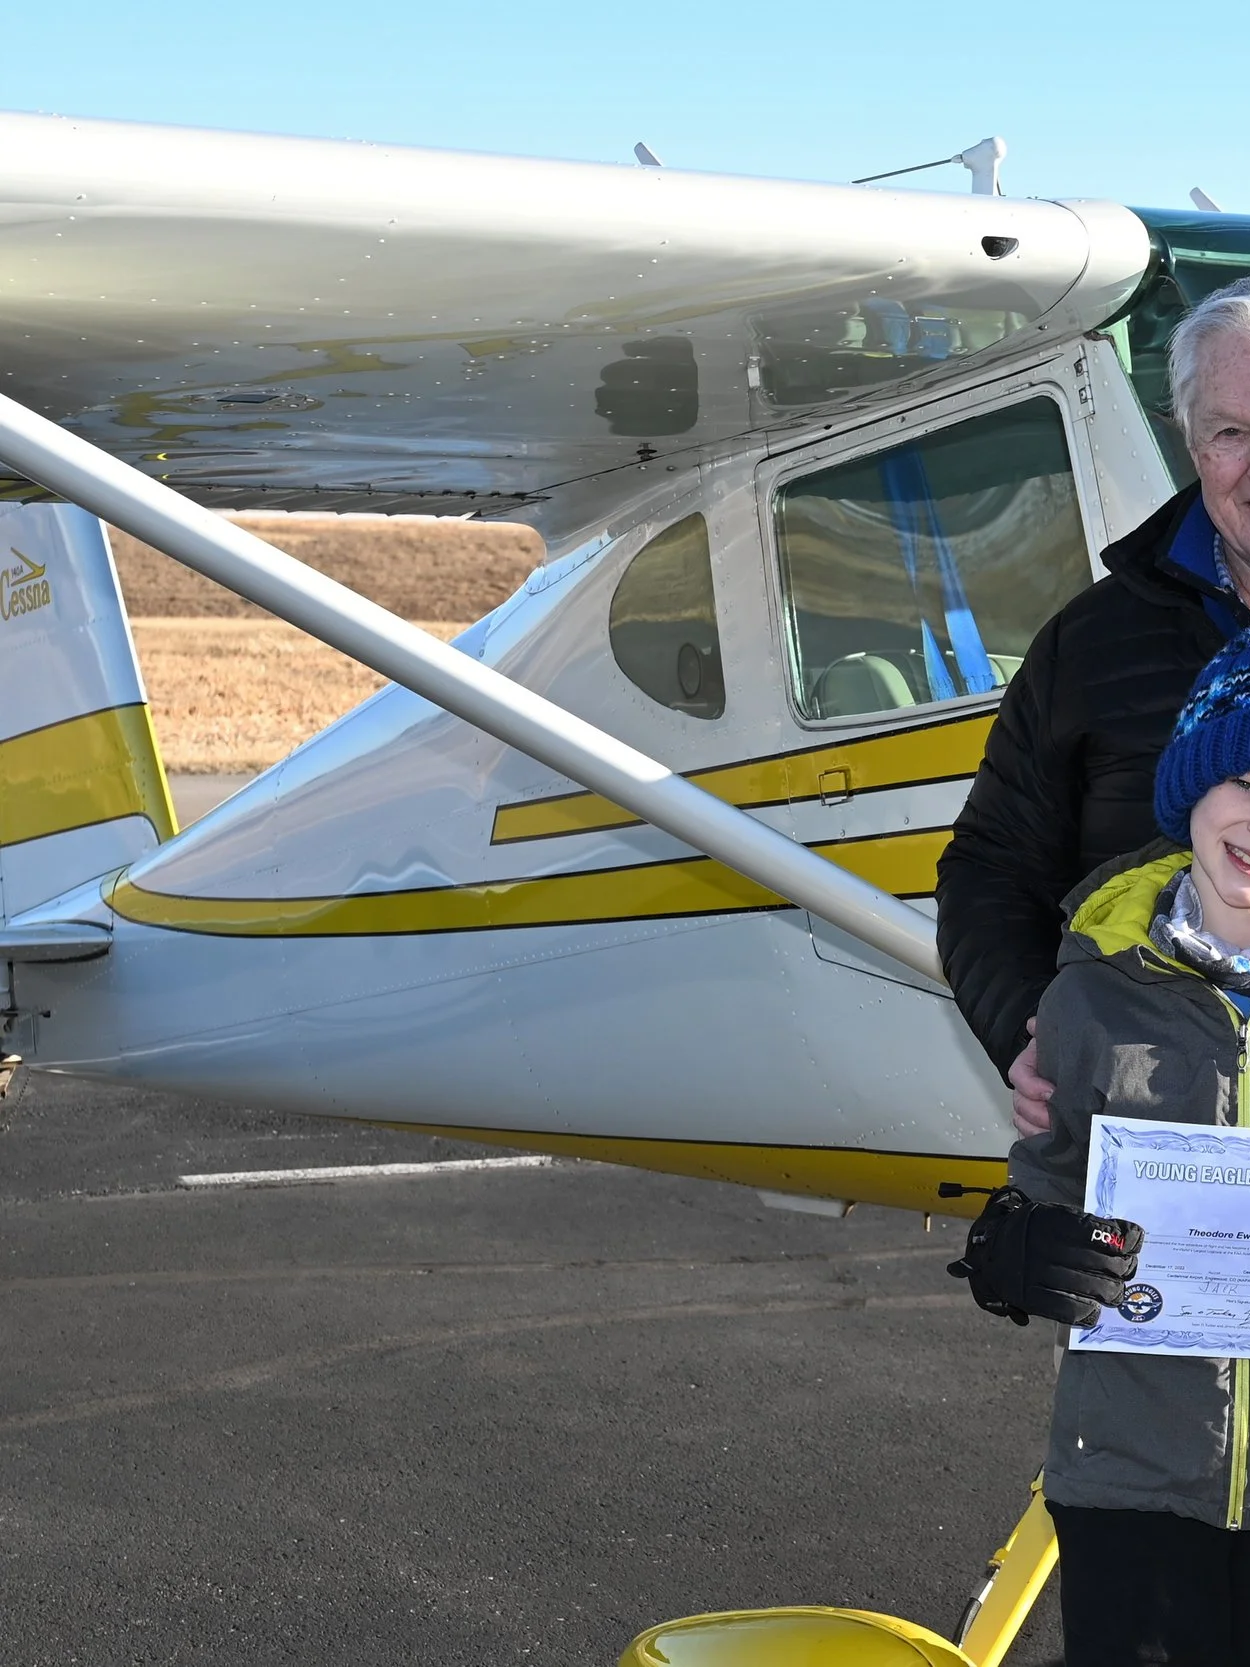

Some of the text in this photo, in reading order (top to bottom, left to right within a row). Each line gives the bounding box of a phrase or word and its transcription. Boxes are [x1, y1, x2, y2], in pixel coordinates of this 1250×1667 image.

[0, 569, 50, 621] Cessna
[1133, 1160, 1197, 1183] YOUNG
[1188, 1228, 1234, 1239] Theodore
